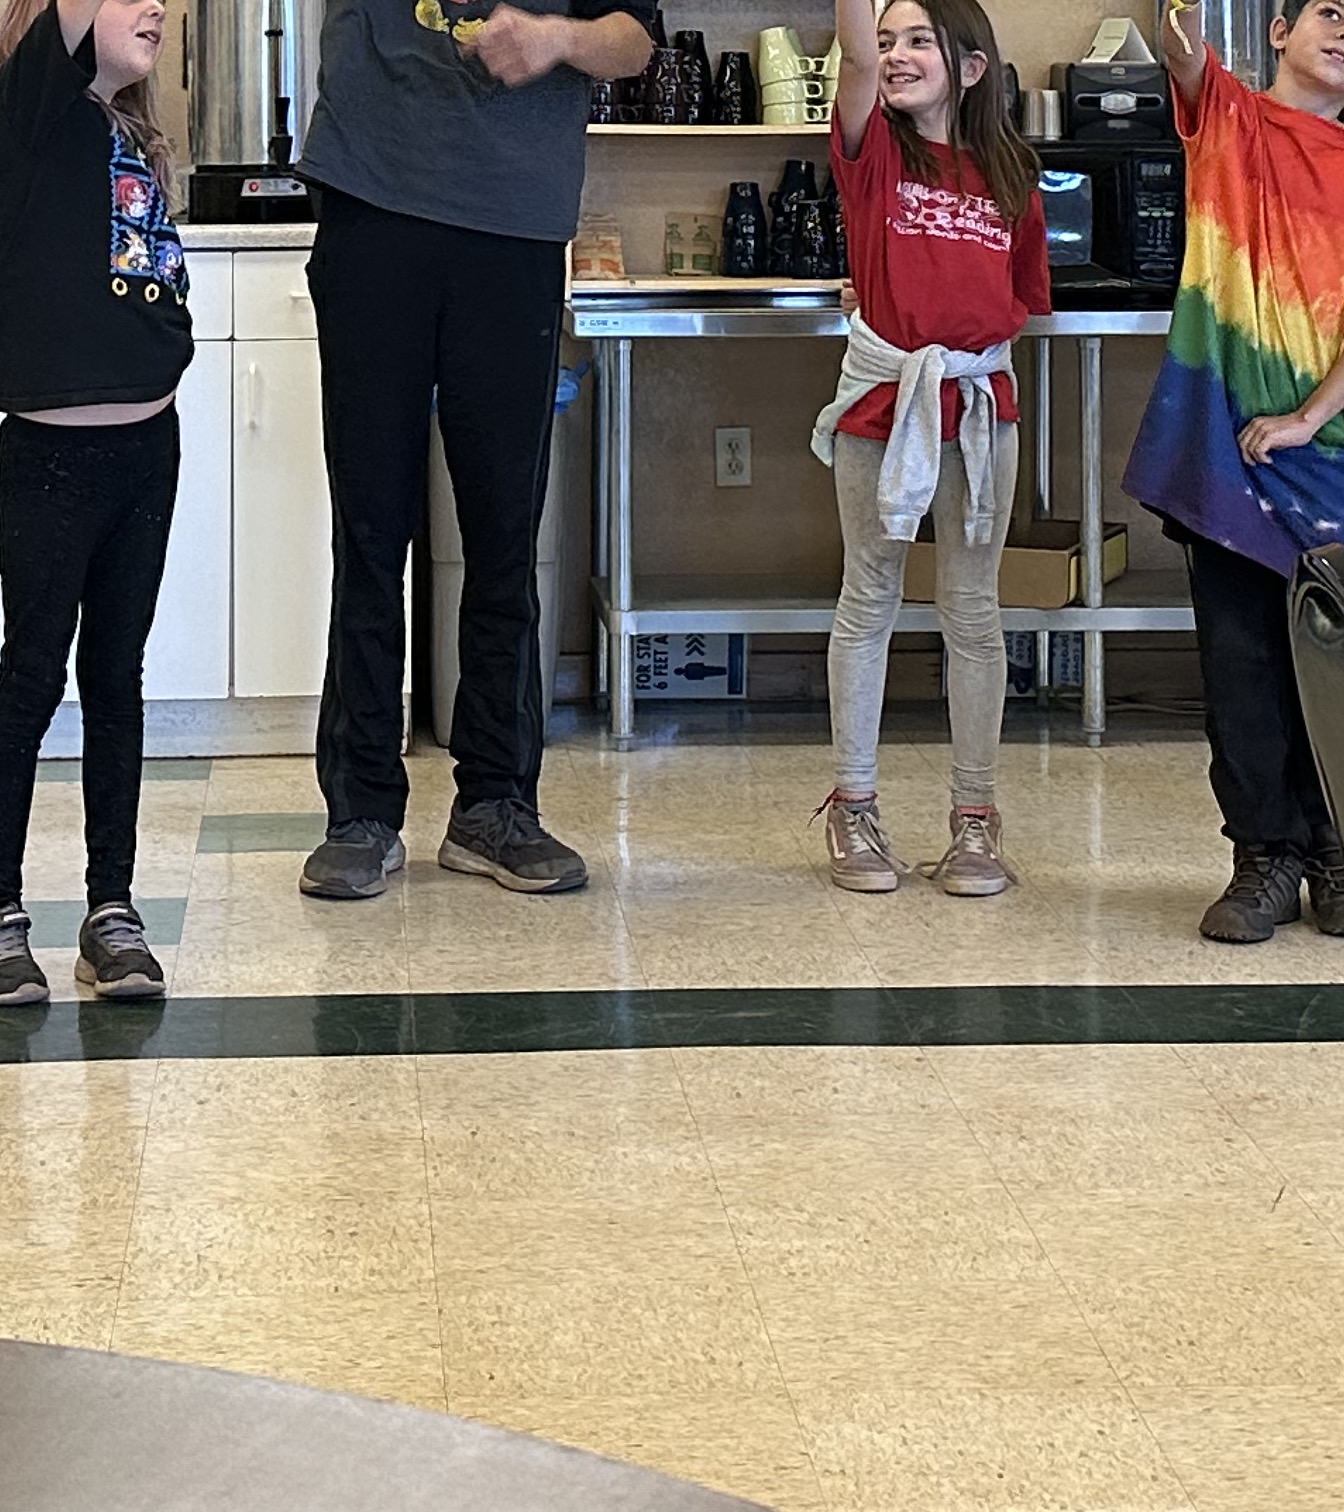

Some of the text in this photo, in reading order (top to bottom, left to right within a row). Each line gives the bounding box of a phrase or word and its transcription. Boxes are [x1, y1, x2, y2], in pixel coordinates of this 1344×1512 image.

[635, 634, 651, 690] FOR STA
[653, 649, 668, 676] FEET
[653, 681, 668, 690] 6
